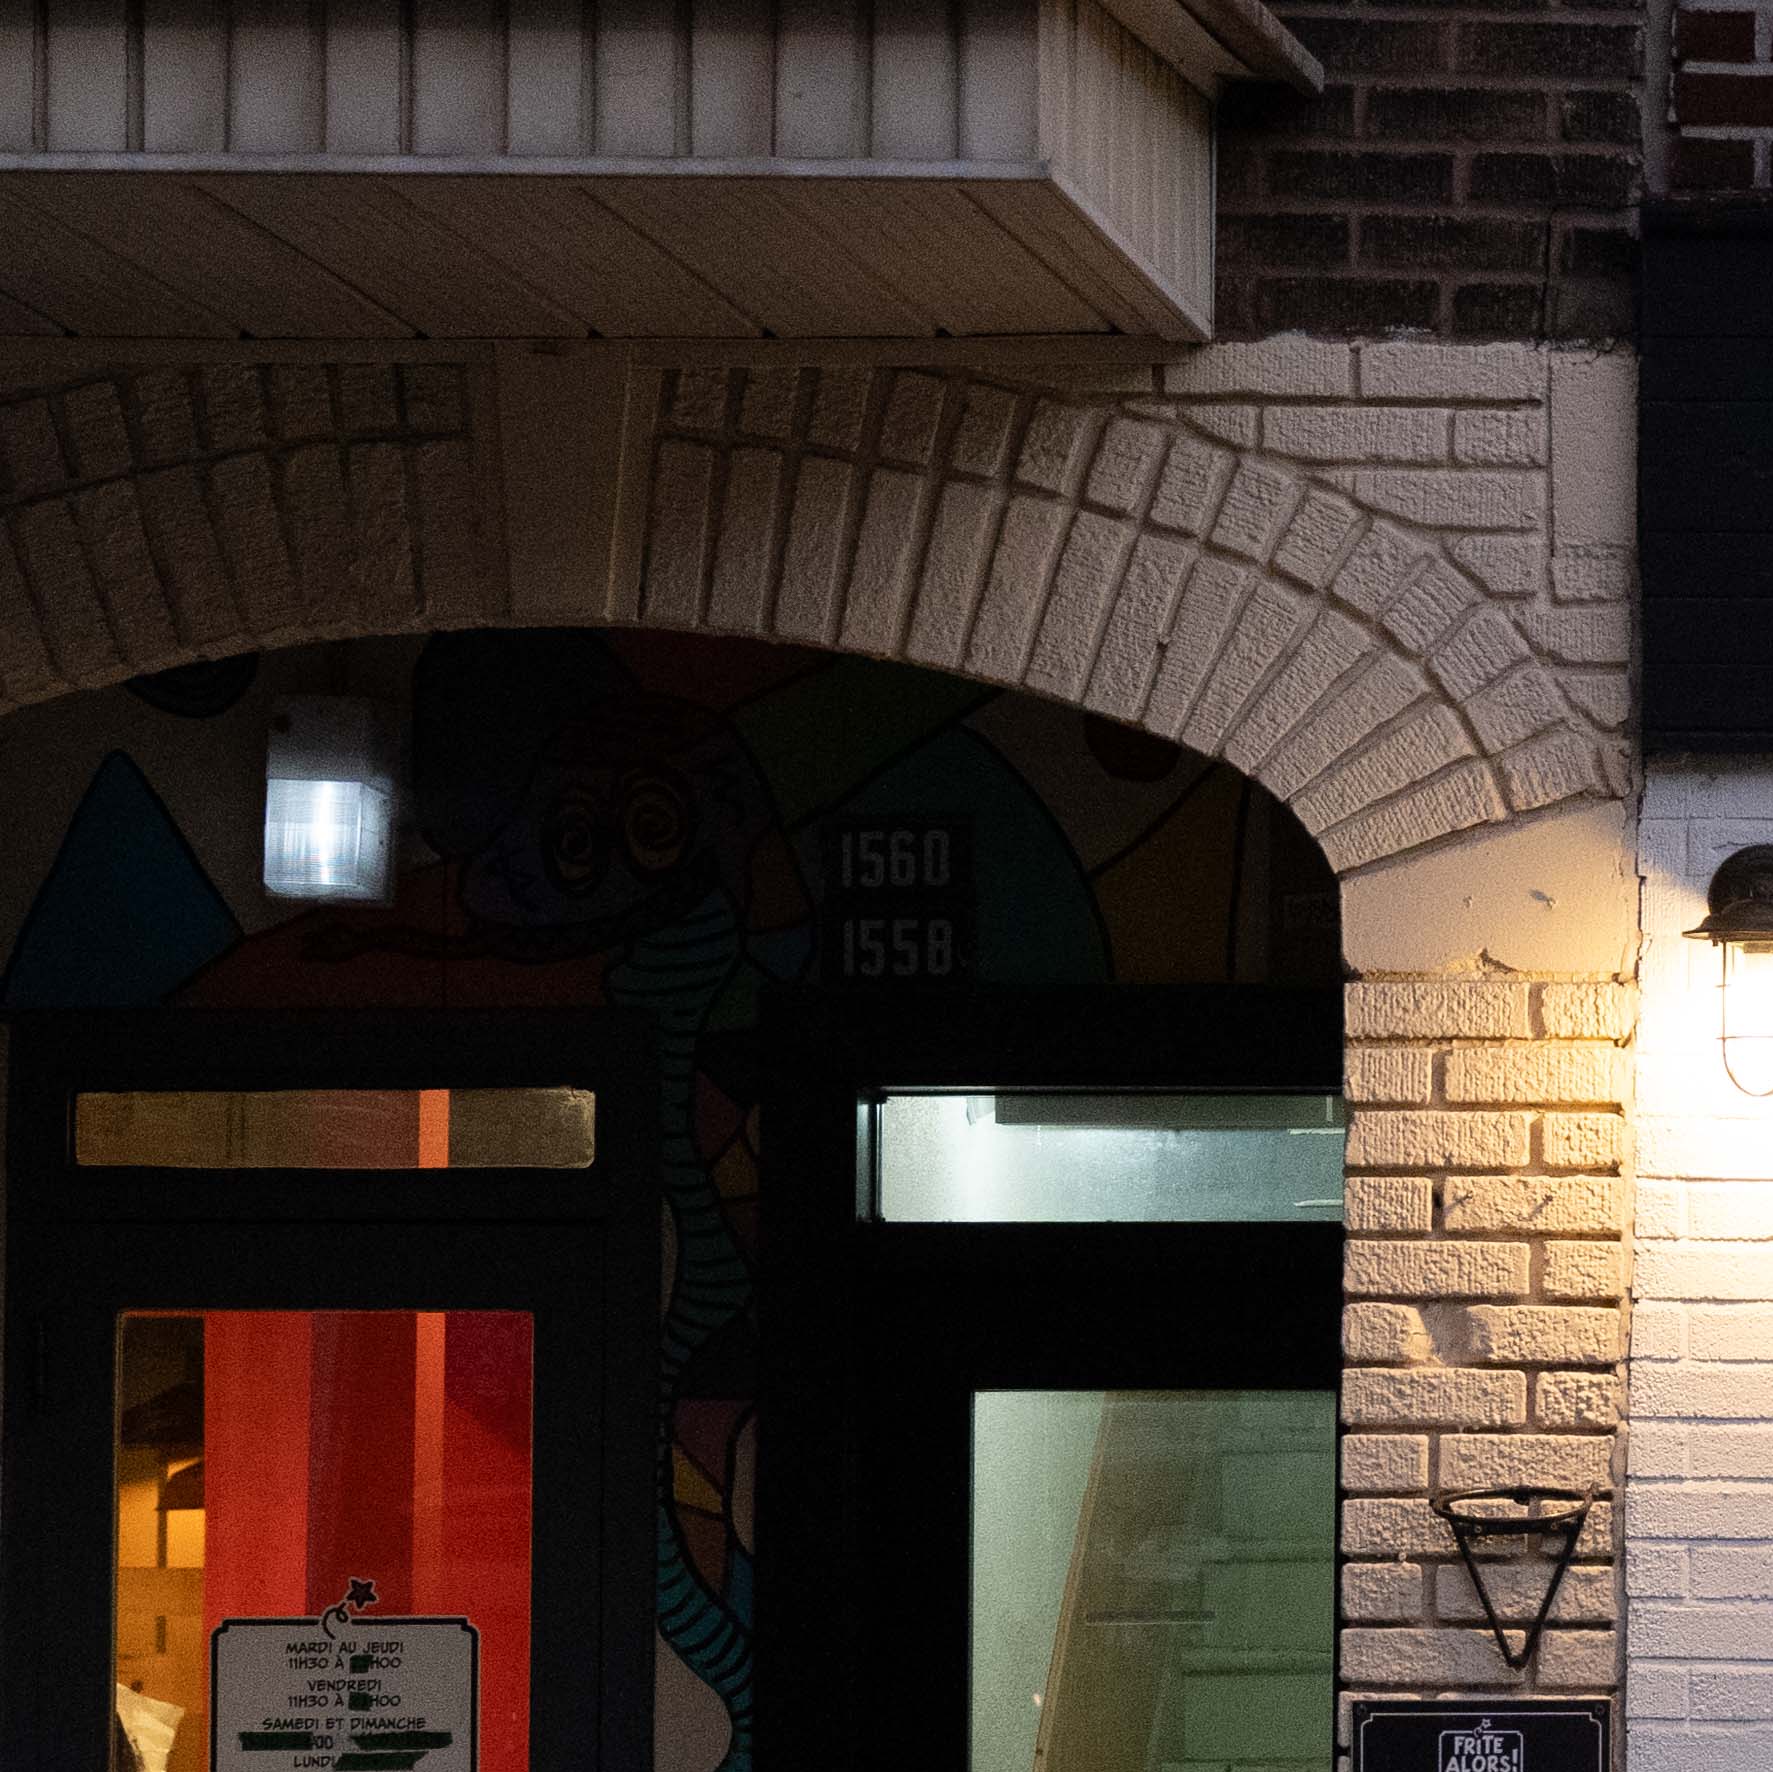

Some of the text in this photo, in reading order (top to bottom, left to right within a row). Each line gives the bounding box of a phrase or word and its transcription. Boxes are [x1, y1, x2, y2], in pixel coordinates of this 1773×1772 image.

[840, 828, 951, 888] 1560
[842, 919, 953, 976] 1558
[286, 1642, 403, 1654] MARDI AU JEUDI
[289, 1657, 328, 1669] 11H30
[334, 1655, 344, 1669] À
[307, 1680, 382, 1692] VENDREDI
[288, 1695, 328, 1708] 11H30
[334, 1694, 344, 1707] À
[262, 1717, 427, 1730] SAMEDI ET DIMANCHE
[1453, 1735, 1504, 1755] FRITE
